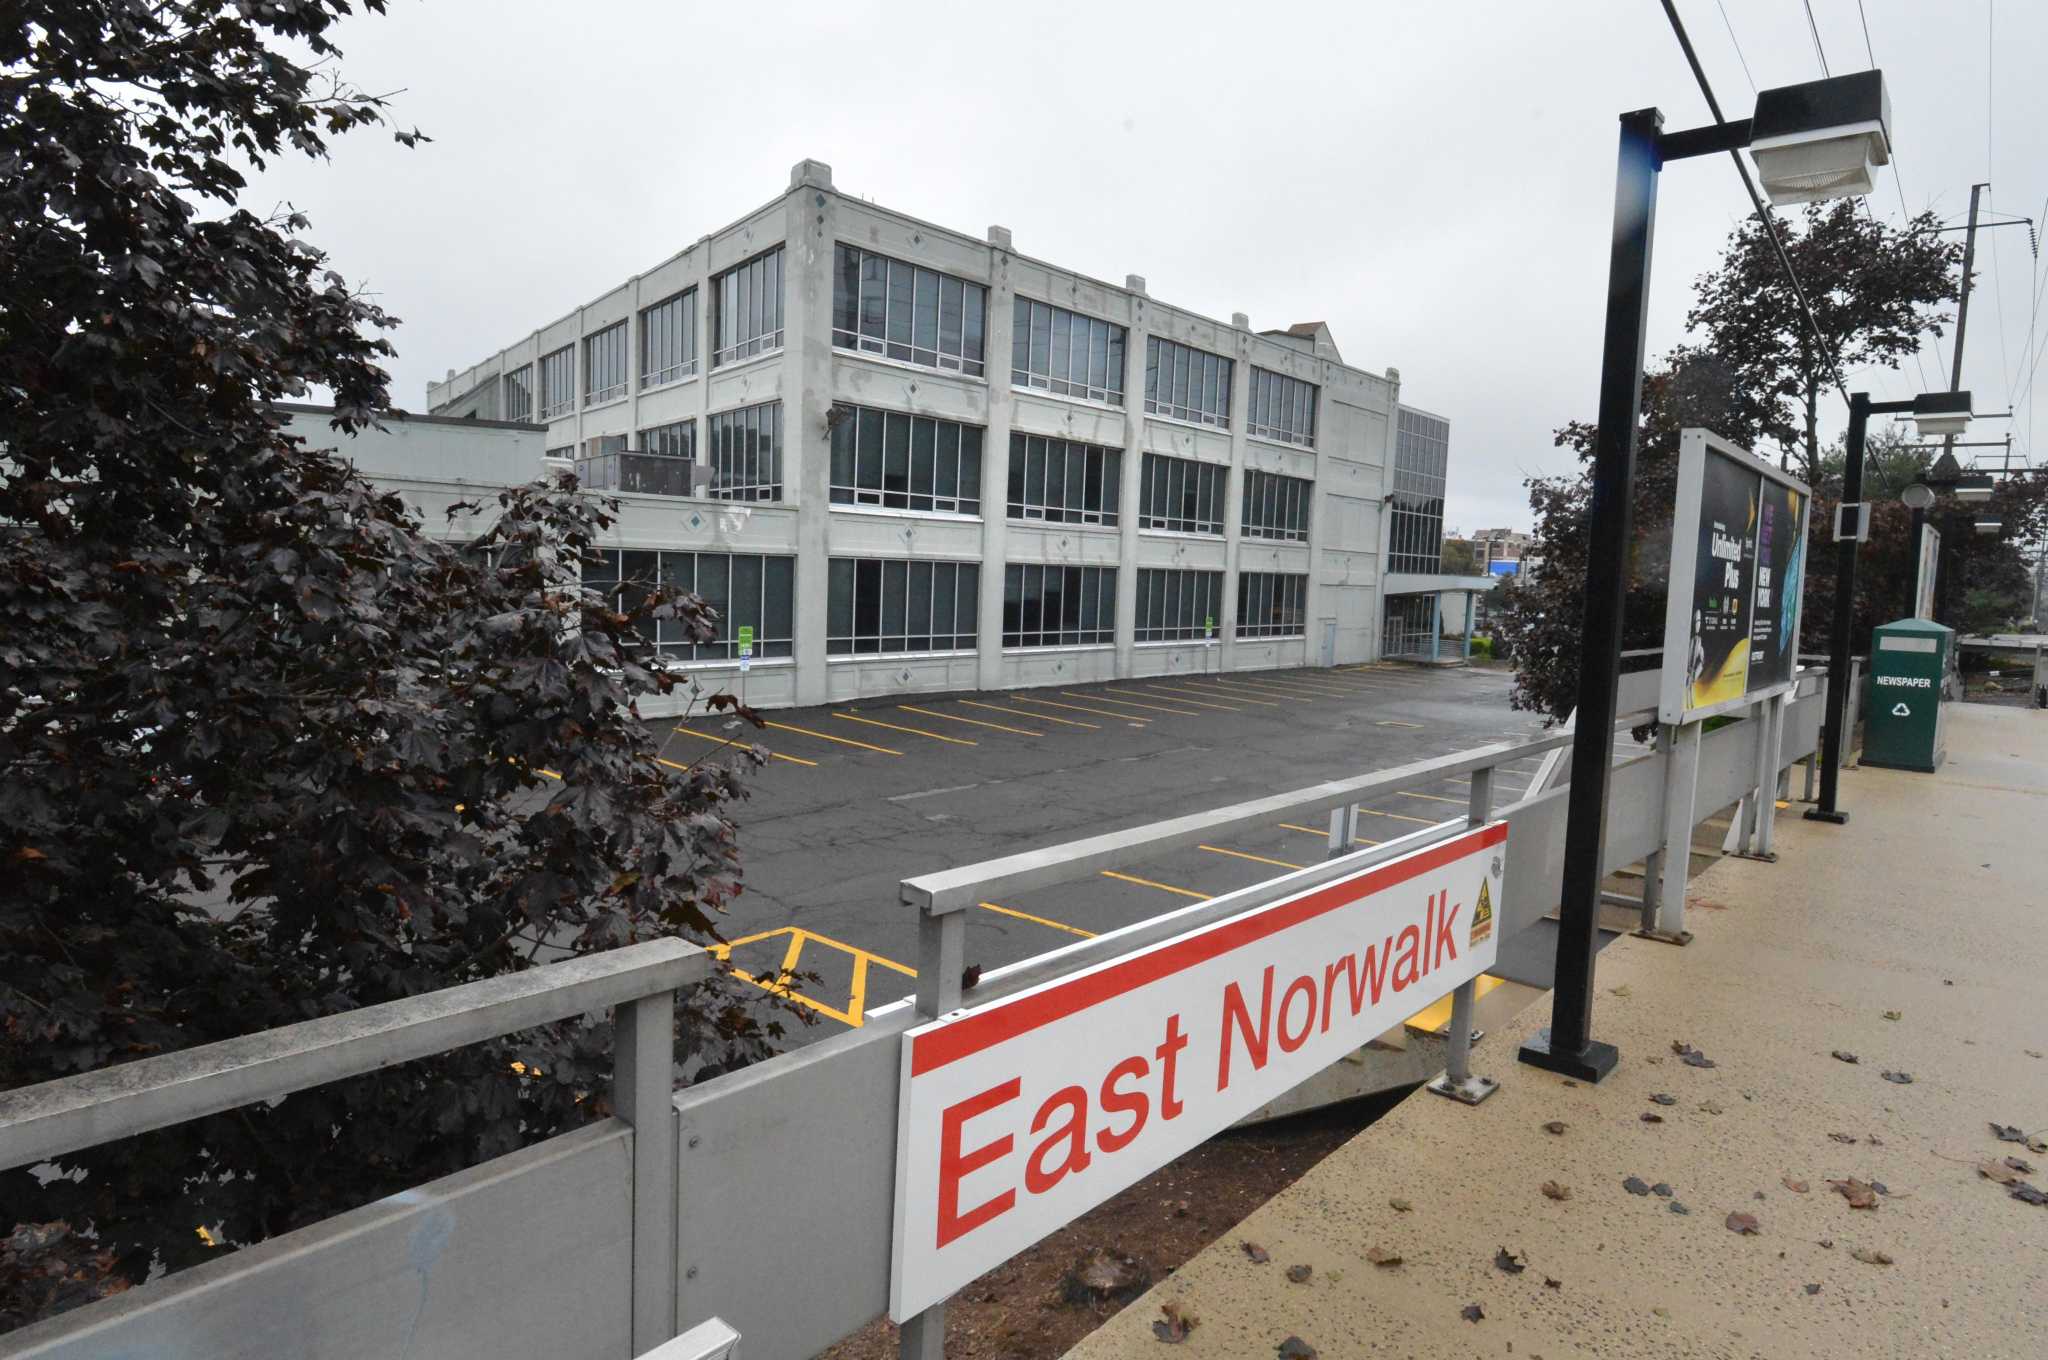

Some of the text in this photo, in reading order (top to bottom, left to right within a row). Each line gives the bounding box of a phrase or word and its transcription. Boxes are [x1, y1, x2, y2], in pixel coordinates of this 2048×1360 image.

[1711, 531, 1742, 562] Unlimited
[1724, 561, 1740, 589] Plus
[1876, 675, 1932, 688] NEWSPAPER
[937, 889, 1461, 1250] East Norwalk
